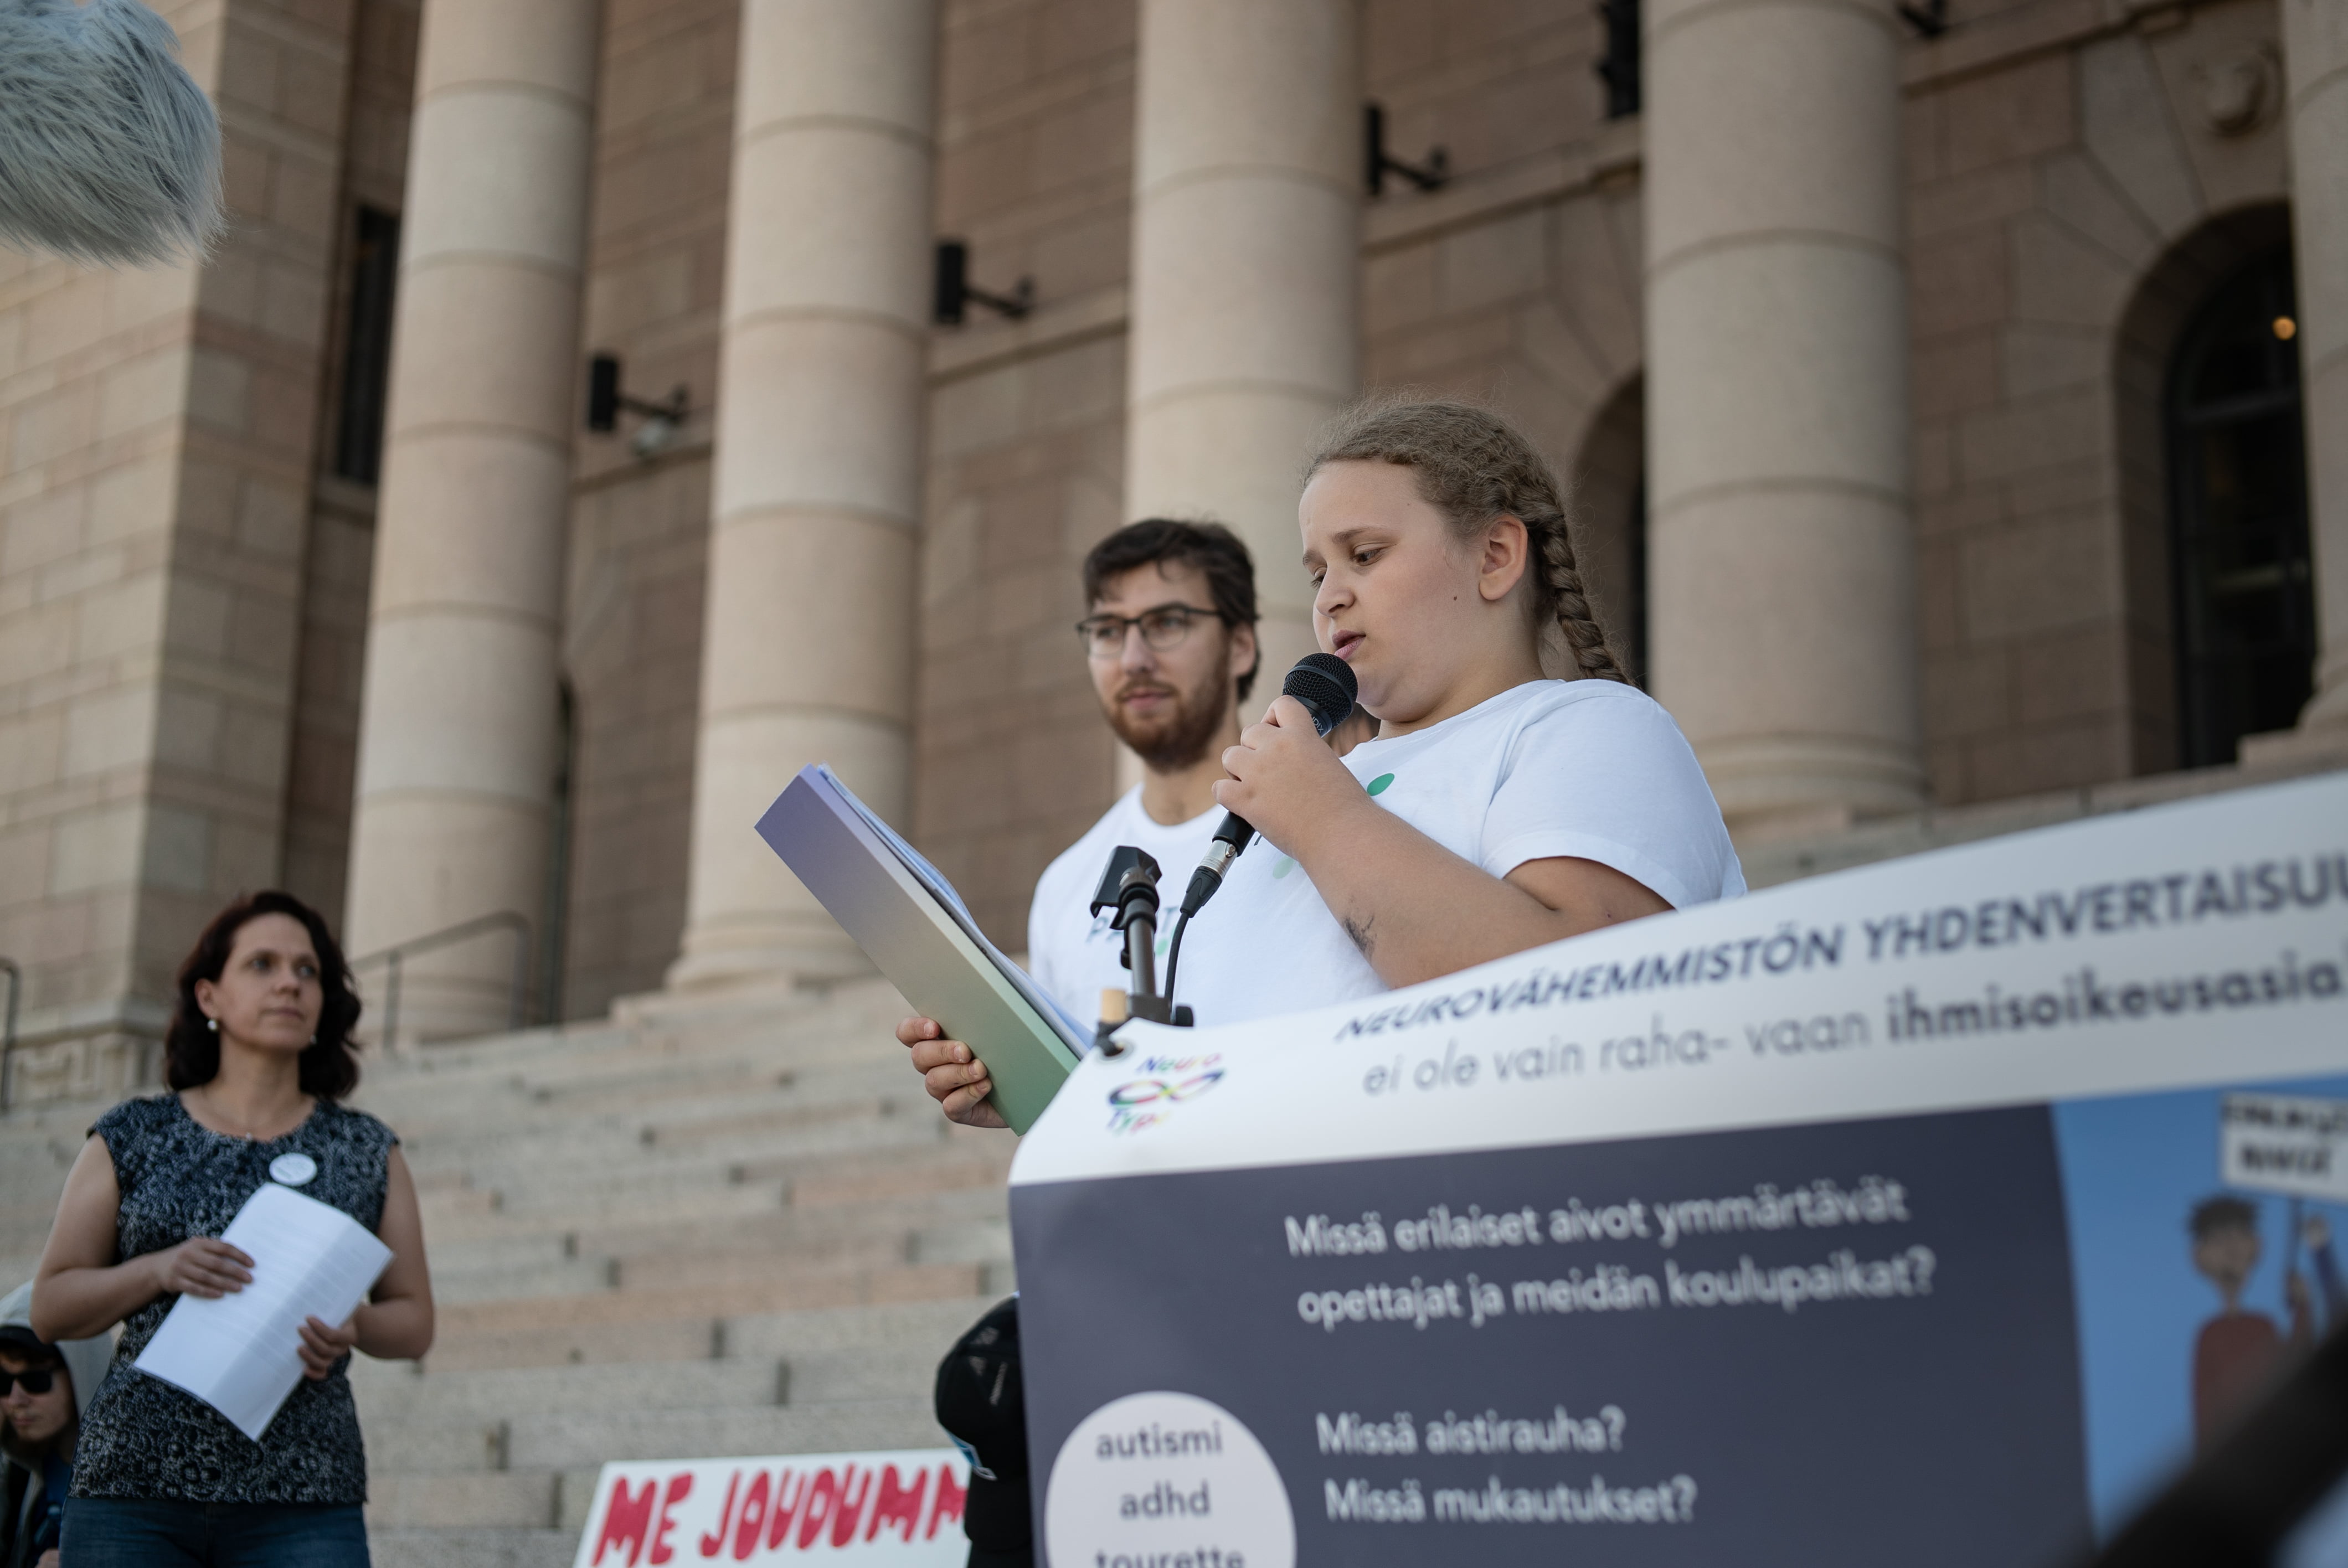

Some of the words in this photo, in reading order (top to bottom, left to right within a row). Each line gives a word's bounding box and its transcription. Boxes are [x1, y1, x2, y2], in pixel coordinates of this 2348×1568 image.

[1333, 919, 1845, 1043] NEUROVÄHEMMISTÖN
[1362, 1059, 1400, 1096] ei
[1413, 1039, 1479, 1091] ole
[1494, 1034, 1584, 1082] vain
[1599, 1012, 1731, 1072] raha-
[1744, 1008, 1873, 1056] vaan
[1284, 1210, 1388, 1257] Missä
[1394, 1203, 1543, 1252] erilaiset
[1549, 1196, 1650, 1244] aivot
[1655, 1174, 1912, 1249] ymmärtävät
[1297, 1275, 1465, 1332] opettajat
[1466, 1273, 1505, 1328] ja
[1511, 1264, 1662, 1314] meidän
[1664, 1245, 1937, 1314] koulupaikat?
[1095, 1421, 1223, 1459] autismi
[1315, 1411, 1418, 1456] Missä
[1425, 1405, 1626, 1453] aistirauha?
[590, 1473, 694, 1568] ME
[1120, 1478, 1211, 1519] adhd
[1324, 1477, 1427, 1523] Missä
[1434, 1473, 1699, 1524] mukautukset?
